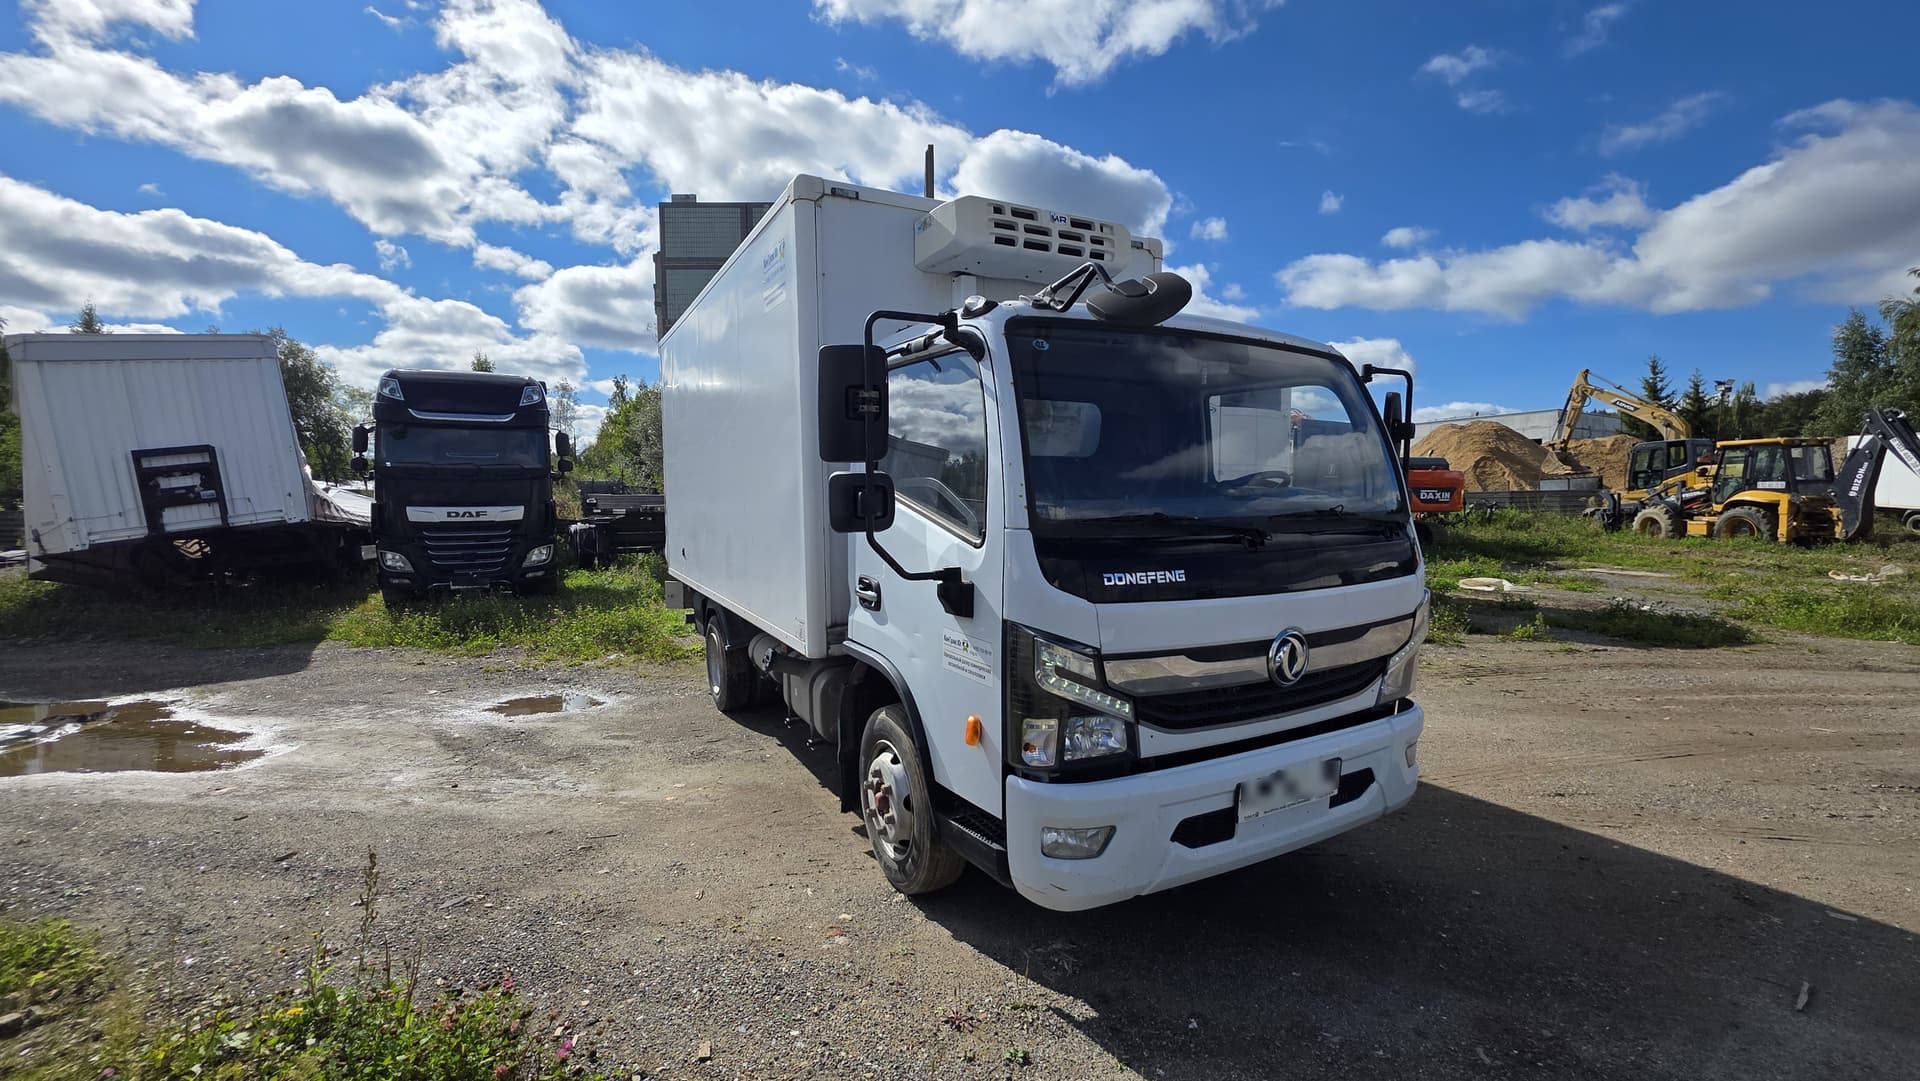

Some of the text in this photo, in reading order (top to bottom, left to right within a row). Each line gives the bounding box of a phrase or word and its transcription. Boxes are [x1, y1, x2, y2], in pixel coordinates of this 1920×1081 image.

[1850, 467, 1867, 492] BIZON
[1420, 492, 1450, 500] DAXIN
[446, 510, 488, 518] DAF
[1103, 569, 1186, 586] DONGFENG
